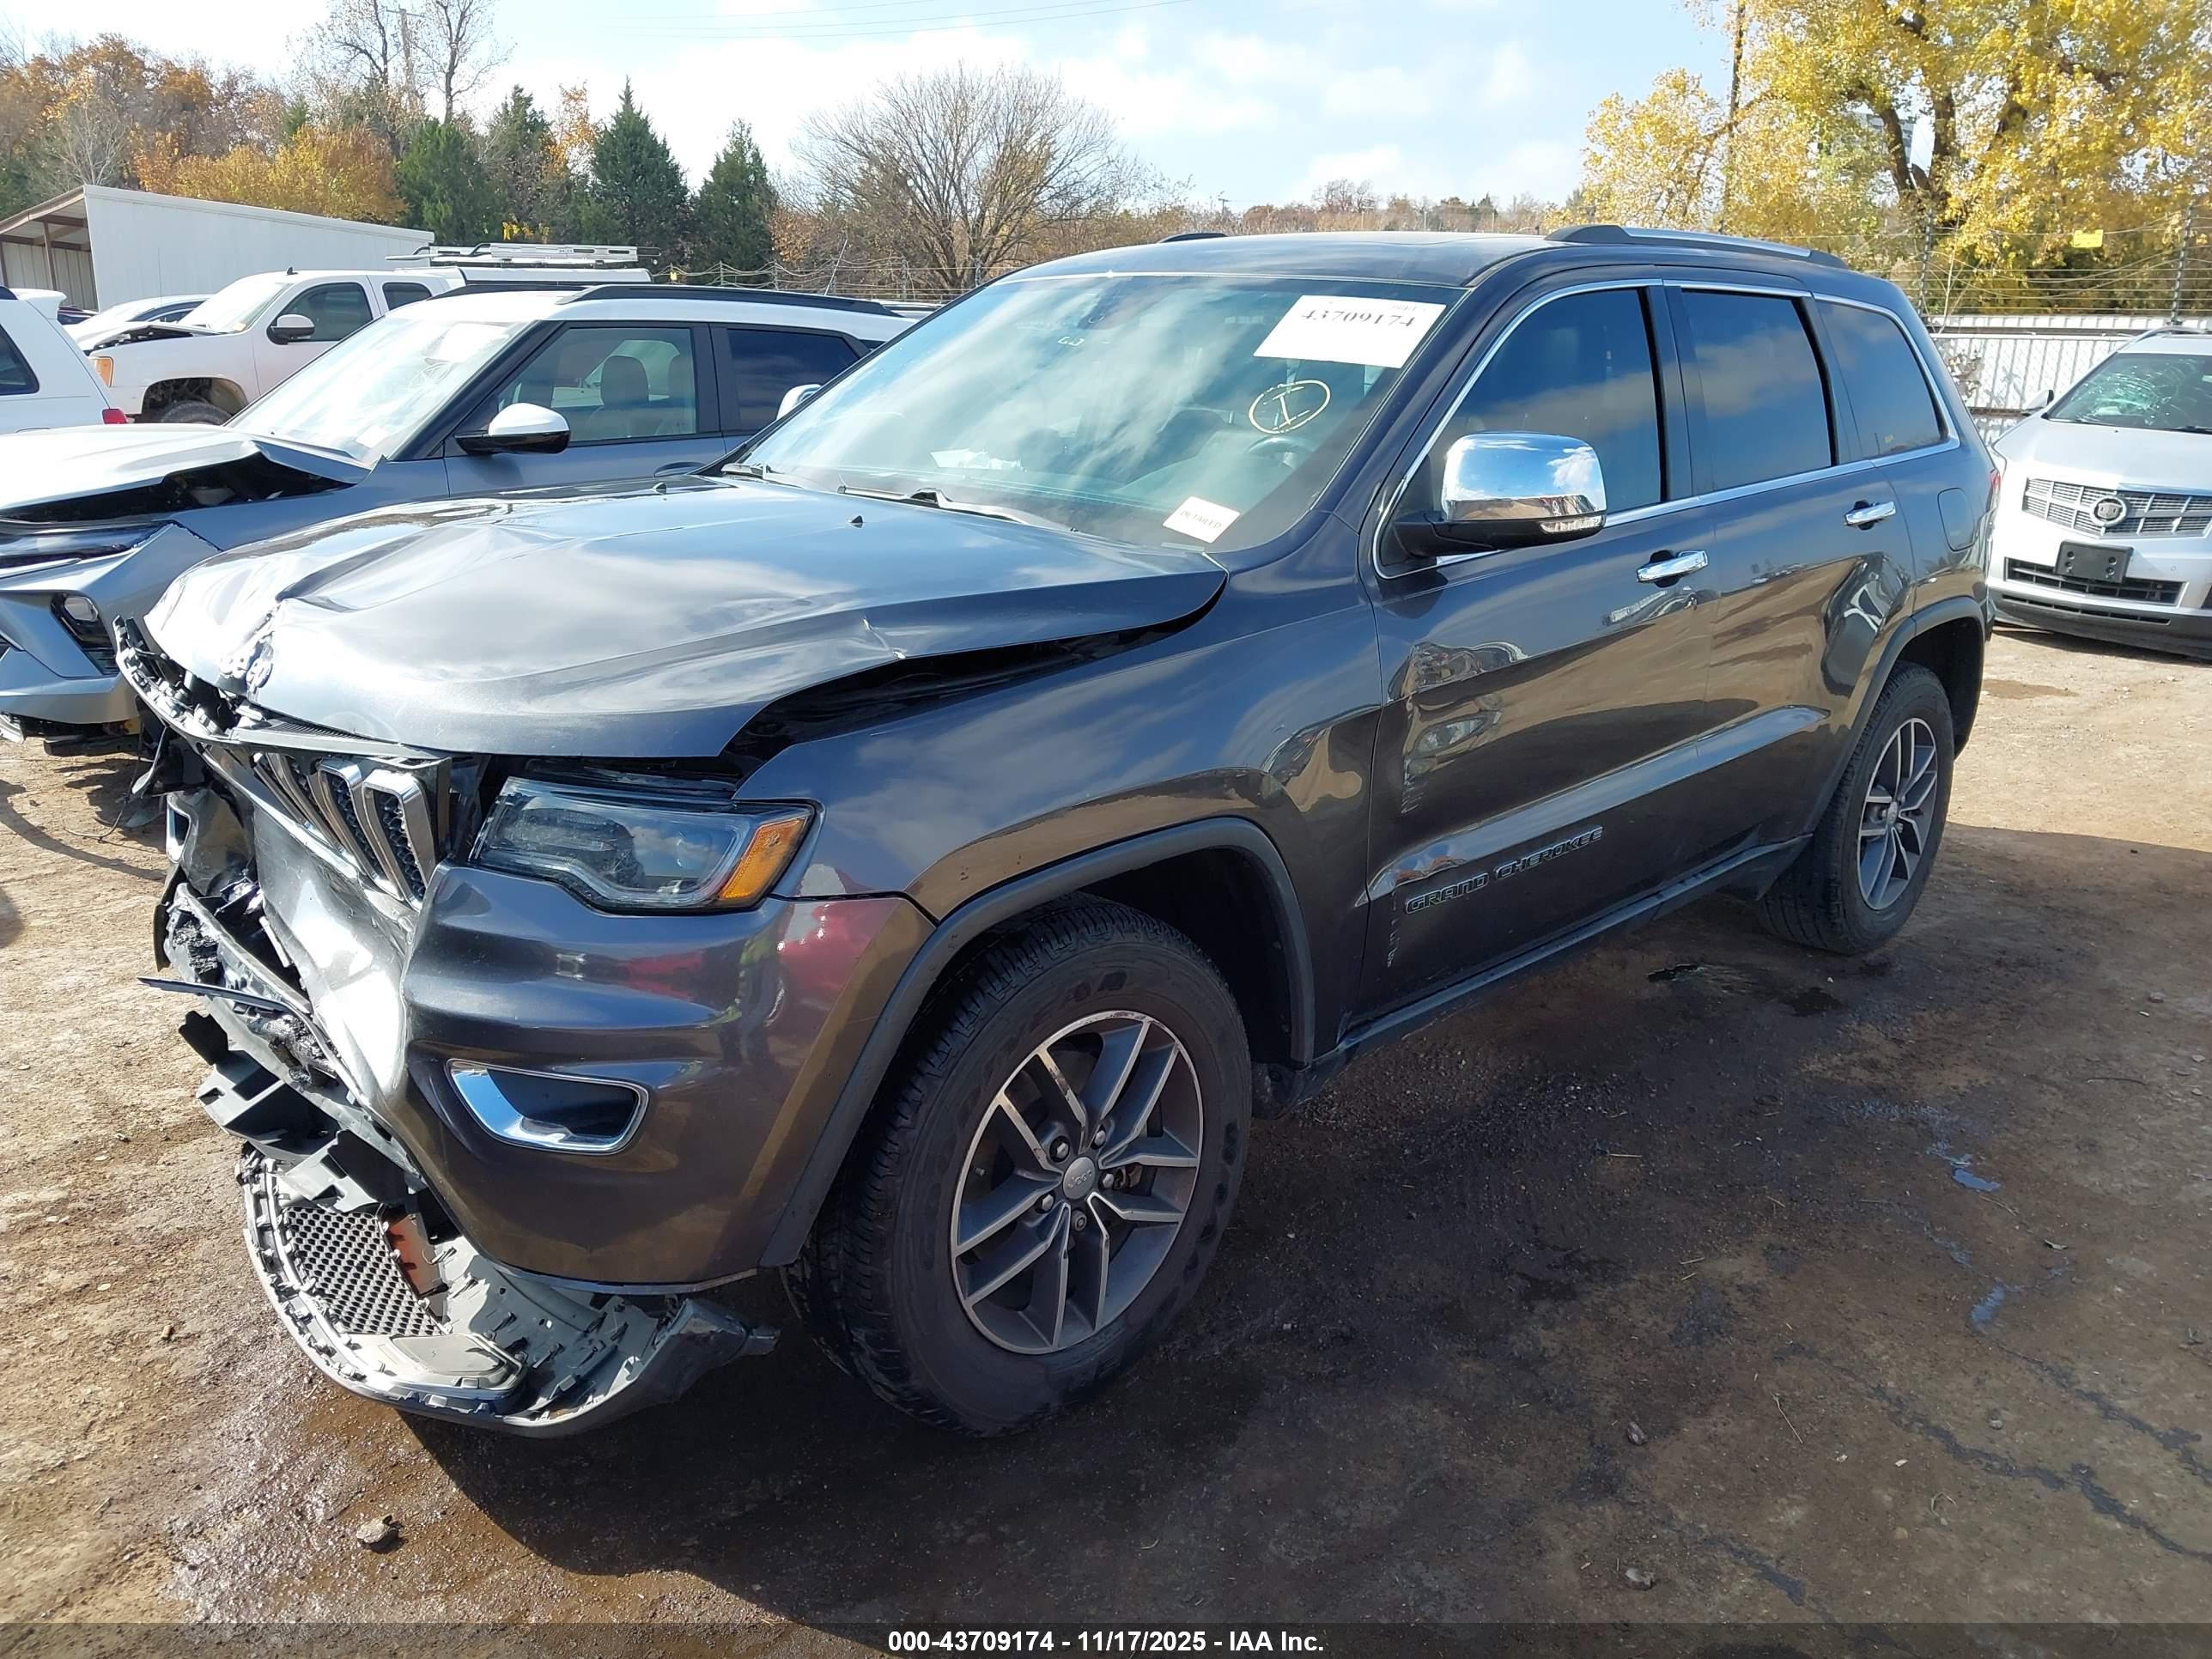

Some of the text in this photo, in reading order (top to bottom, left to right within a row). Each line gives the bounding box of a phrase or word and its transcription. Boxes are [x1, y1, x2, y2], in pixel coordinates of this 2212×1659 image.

[1300, 308, 1416, 328] 43709174
[1404, 825, 1604, 915] GRAND CHEROKEE
